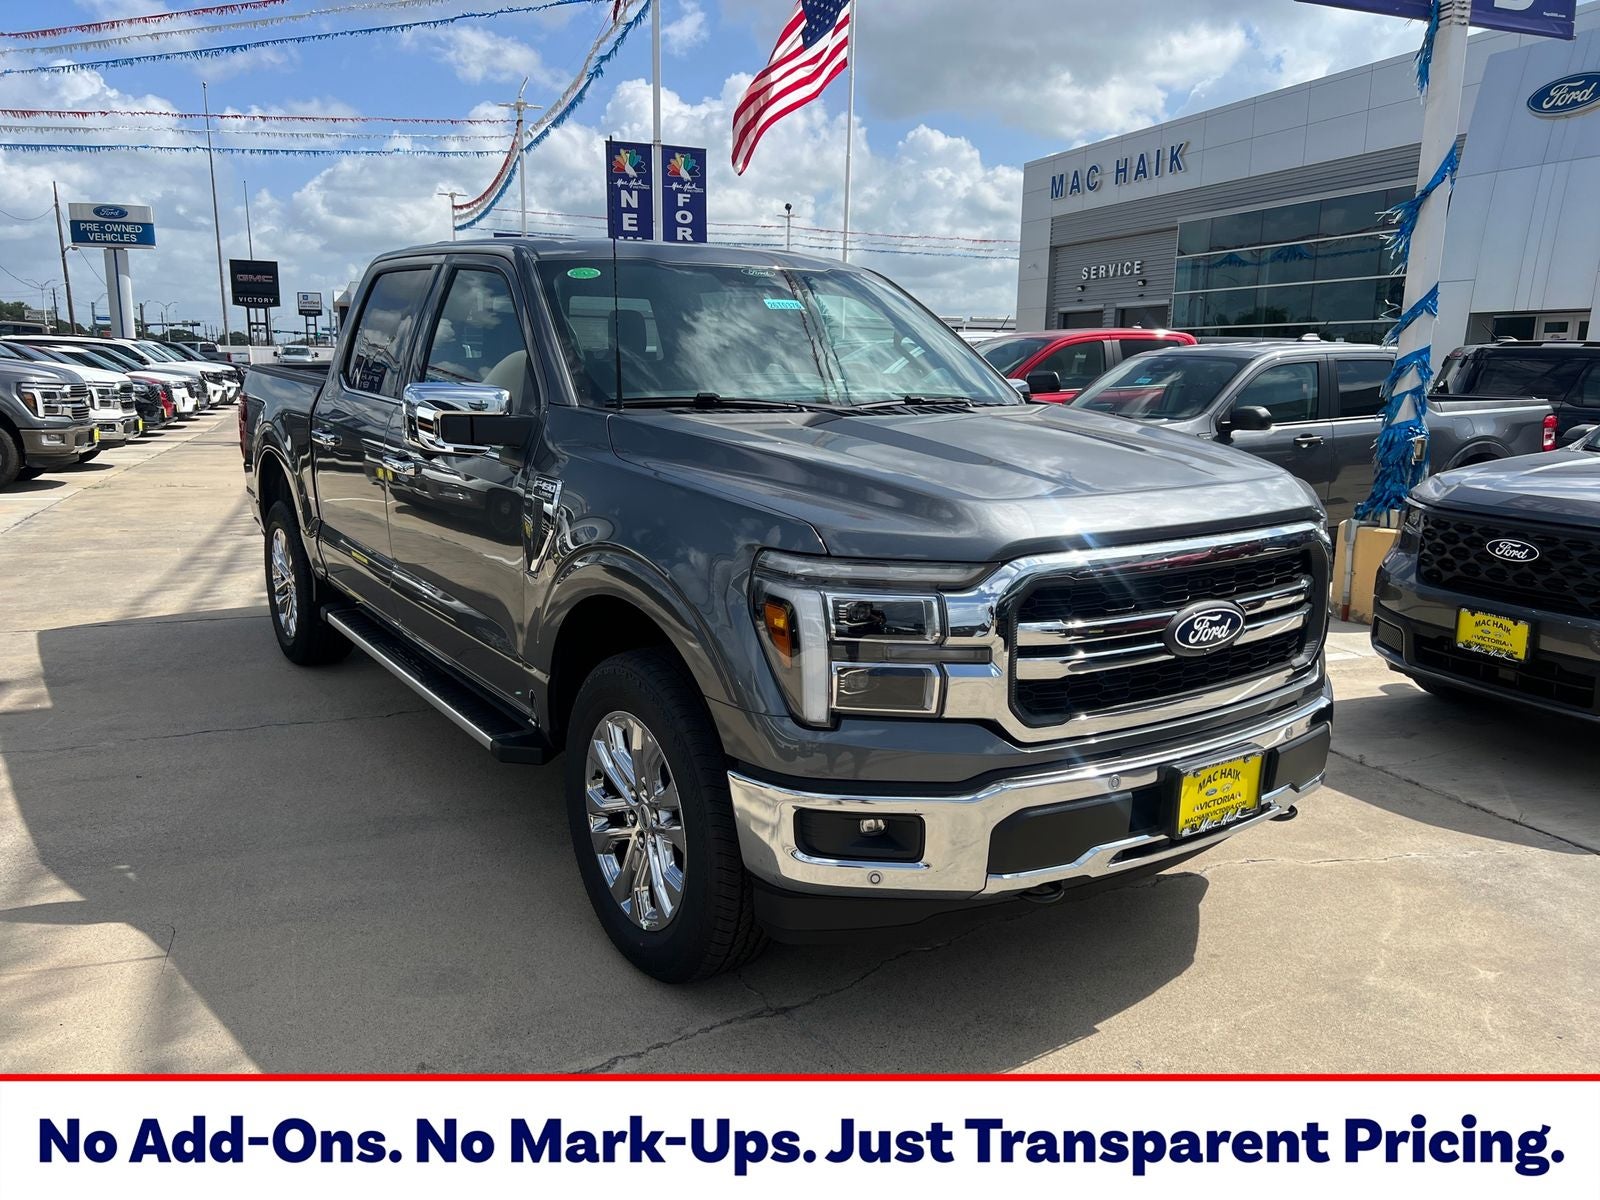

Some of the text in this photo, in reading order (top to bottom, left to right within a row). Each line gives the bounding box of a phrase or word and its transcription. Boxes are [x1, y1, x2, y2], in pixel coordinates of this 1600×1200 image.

[1542, 80, 1598, 109] Ford
[1050, 142, 1185, 200] MAC HAIK
[99, 208, 120, 217] Ford
[619, 189, 642, 240] NE
[80, 222, 143, 233] PRE-OWNED
[87, 232, 137, 243] VEHICLES
[236, 273, 273, 283] GMC
[1081, 260, 1142, 280] SERVICE
[238, 296, 274, 304] VICTORY
[1495, 541, 1529, 560] Ford
[1188, 614, 1232, 644] Ford
[1475, 619, 1491, 627] MAC
[1492, 620, 1511, 636] HAIK
[1197, 770, 1219, 793] MAC
[1220, 767, 1241, 781] HAIK
[1199, 793, 1235, 811] VICTORIA
